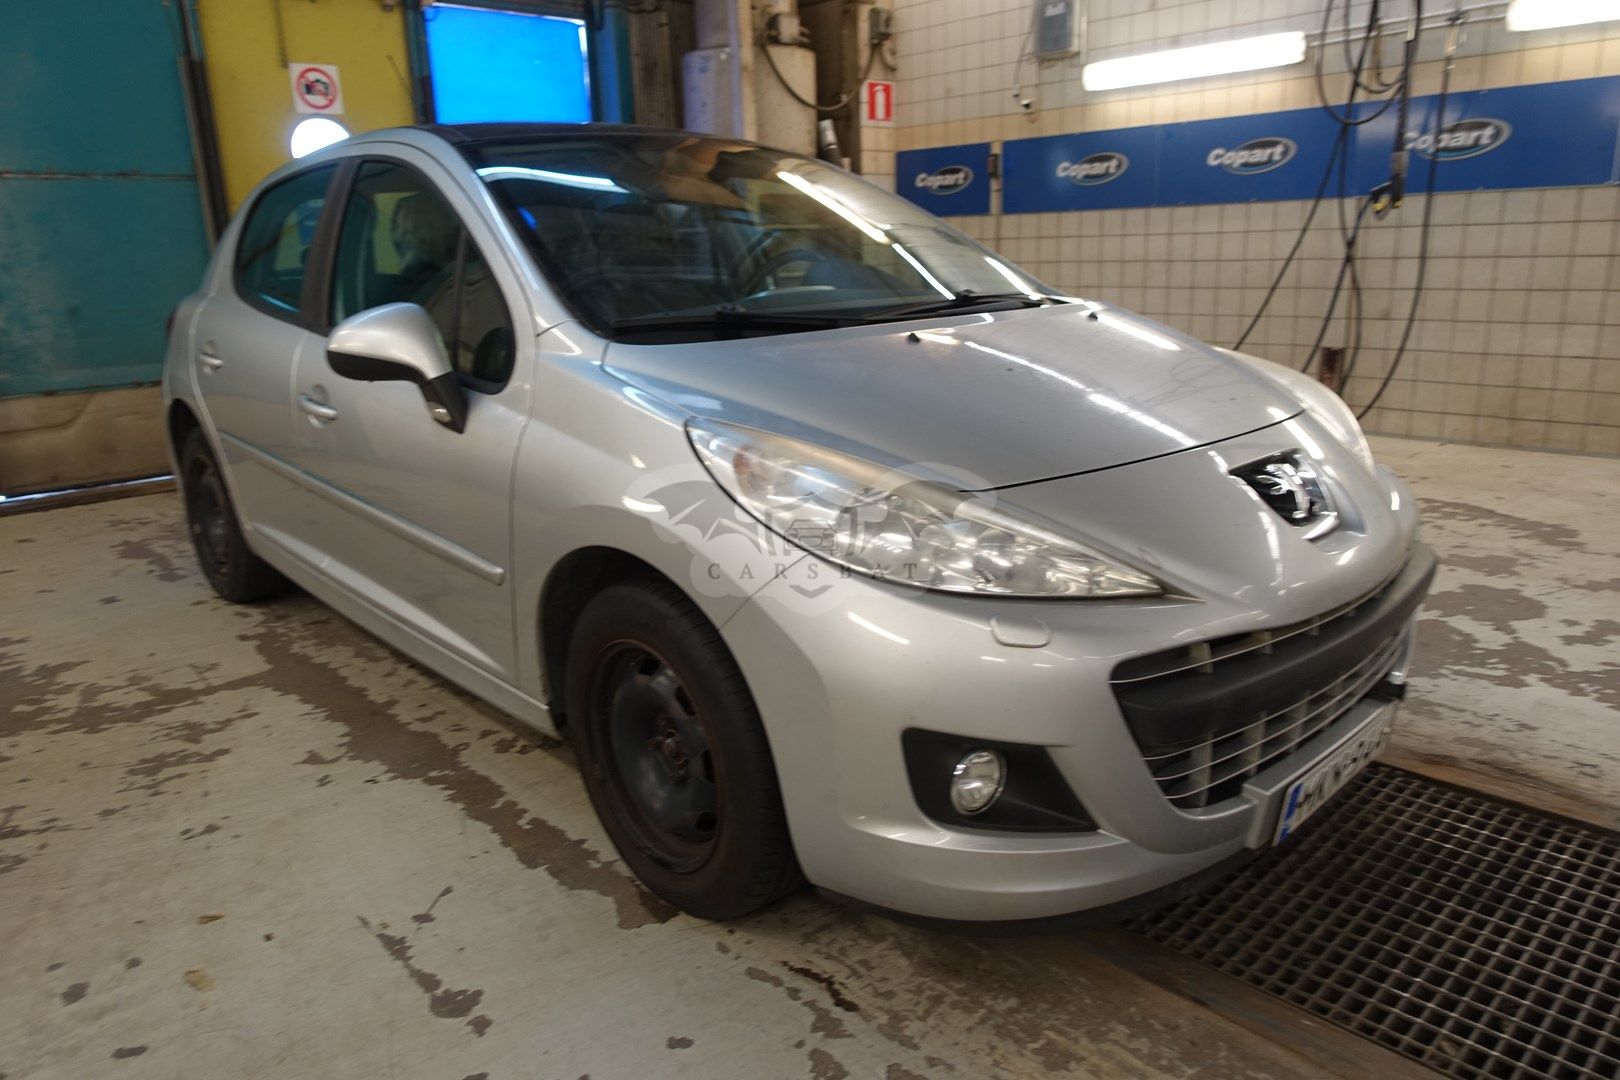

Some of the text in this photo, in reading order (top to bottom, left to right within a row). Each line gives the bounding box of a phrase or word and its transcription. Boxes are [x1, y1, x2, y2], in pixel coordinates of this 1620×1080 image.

[1206, 143, 1285, 168] Copart
[1056, 158, 1119, 179] Copart
[915, 171, 966, 189] Copart
